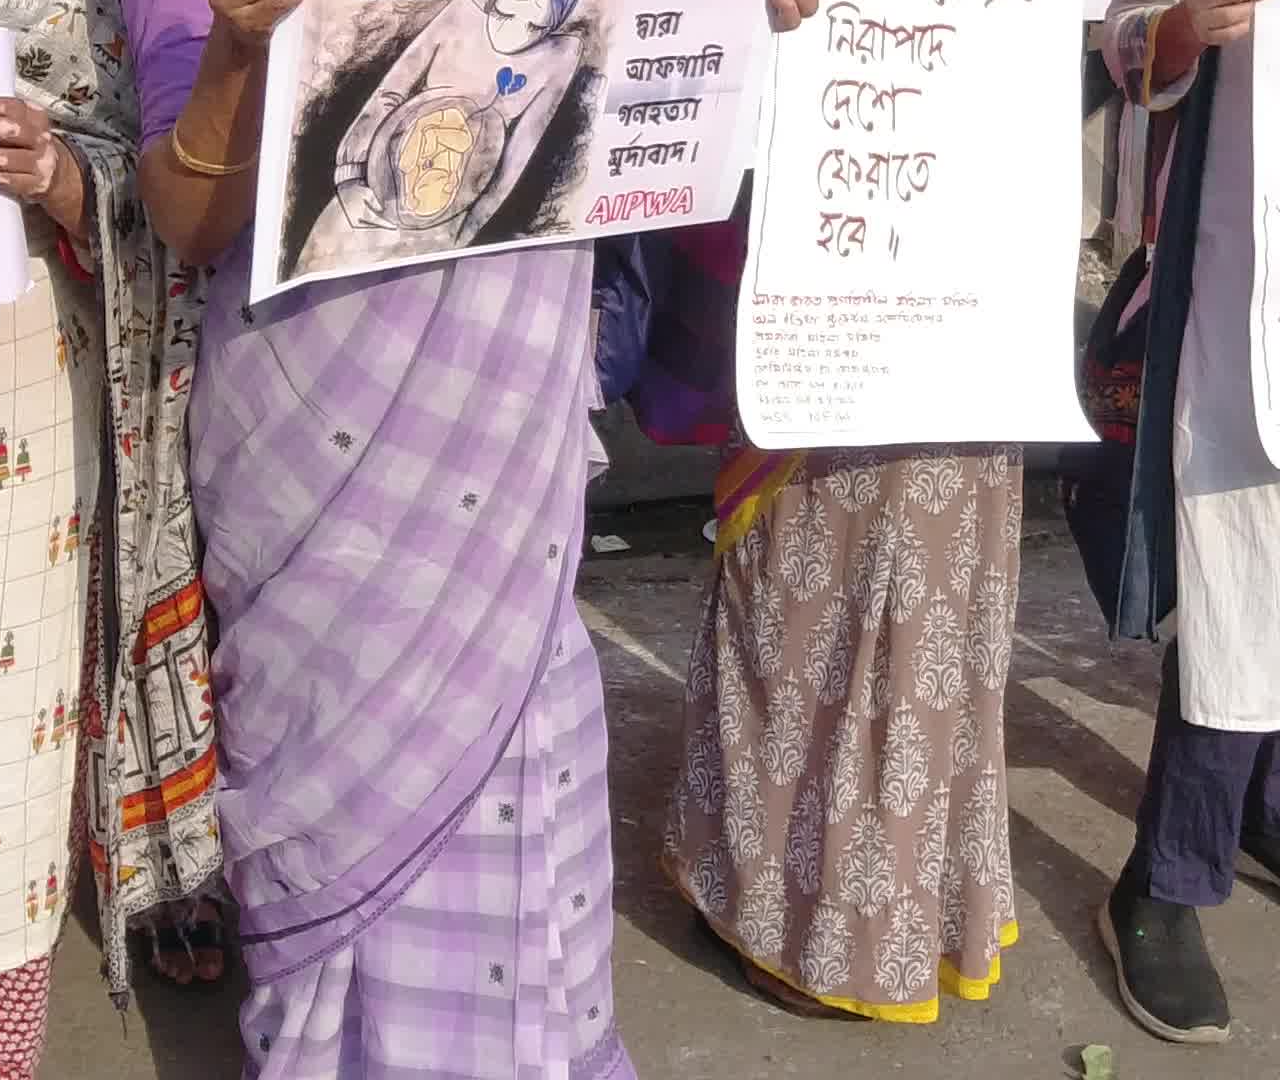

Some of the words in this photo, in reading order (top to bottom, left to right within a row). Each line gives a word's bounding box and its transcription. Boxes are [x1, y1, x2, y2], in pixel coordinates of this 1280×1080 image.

[635, 11, 683, 40] দ্বারা
[825, 0, 957, 72] নিরাপদে
[625, 44, 723, 82] আফগানি
[821, 78, 922, 132] দেশে
[816, 148, 937, 203] ফেরাতে
[585, 185, 694, 225] AIPWA
